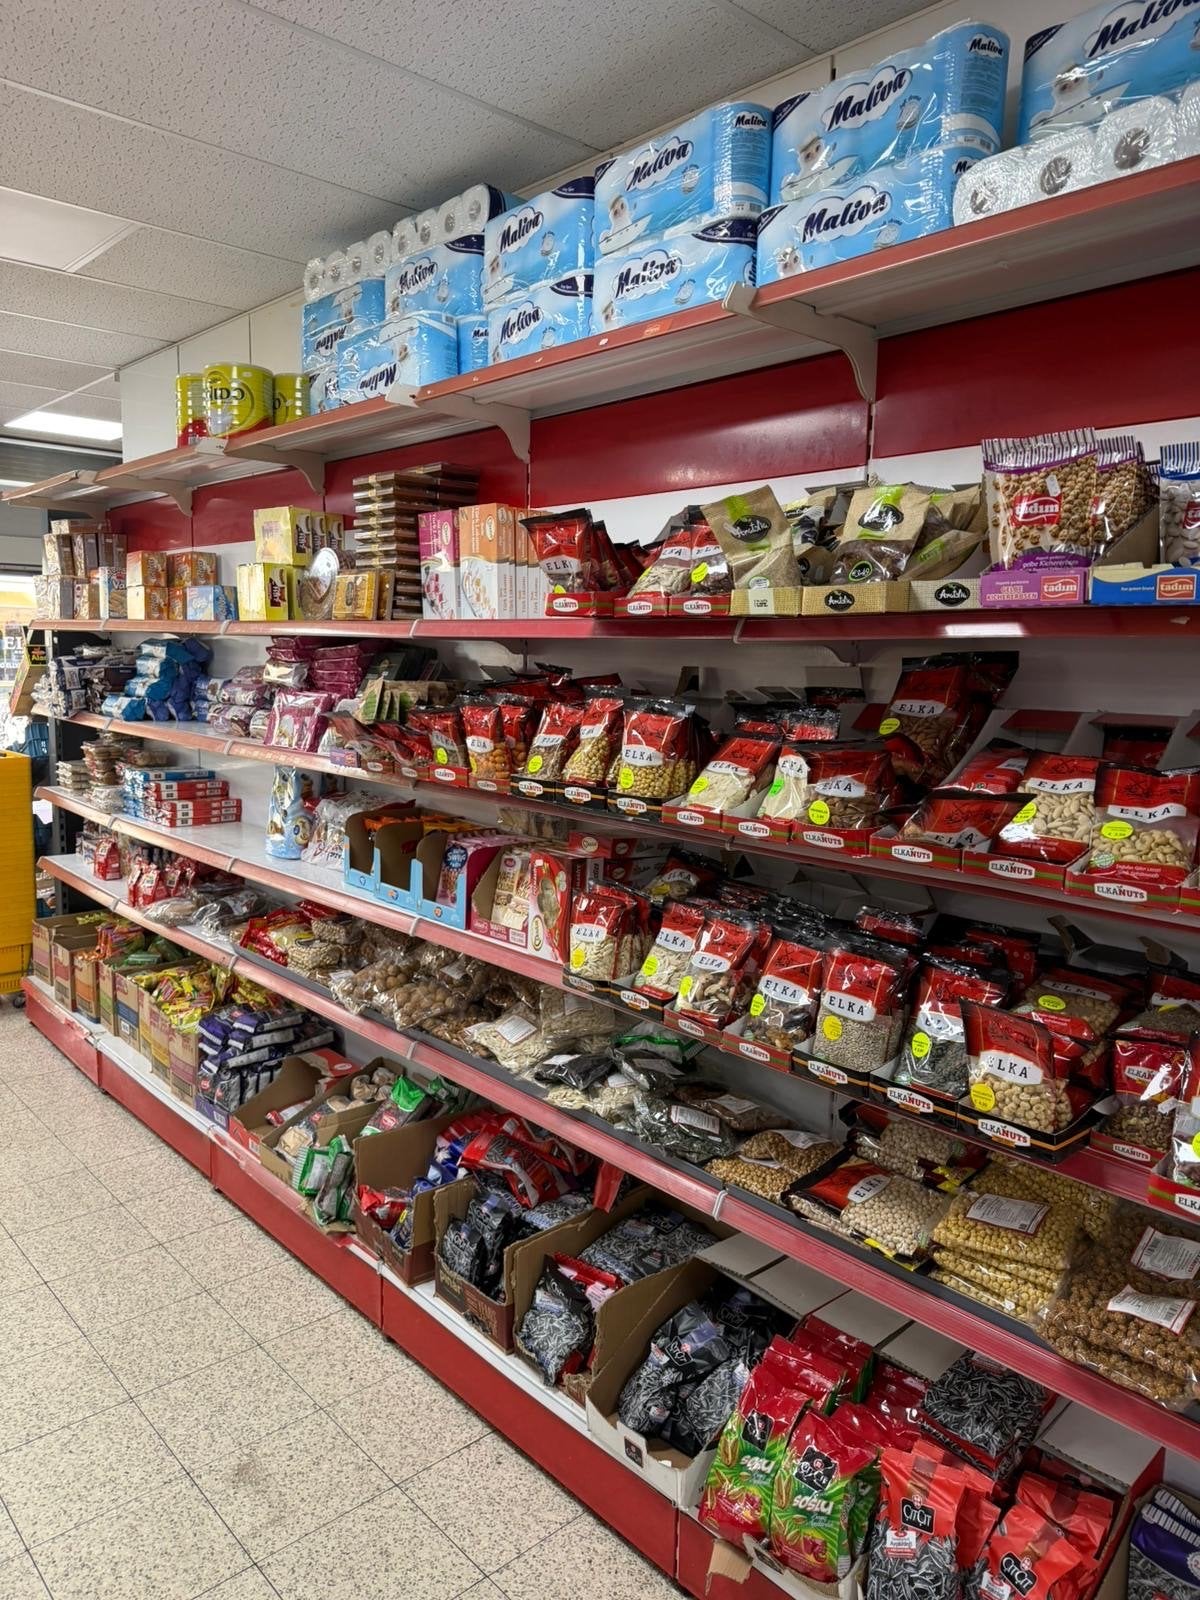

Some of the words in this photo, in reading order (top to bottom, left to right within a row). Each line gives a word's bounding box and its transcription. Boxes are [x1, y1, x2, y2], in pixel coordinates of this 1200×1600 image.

[968, 37, 1003, 56] Maliva
[827, 70, 906, 132] Maliva
[735, 114, 768, 128] Maliva
[626, 142, 690, 192] Maliva
[802, 192, 888, 243] Maliva
[500, 213, 541, 253] Maliva
[400, 261, 436, 295] Maliva
[615, 256, 679, 299] Maliva
[500, 308, 542, 345] Maliva
[315, 326, 347, 350] Maliva
[360, 362, 398, 394] Maliva
[898, 703, 936, 714] ELKA
[625, 749, 653, 761] ELKA
[519, 783, 543, 793] ELKANUTS
[566, 789, 591, 800] ELKANUTS
[1038, 780, 1085, 791] ELKA
[618, 800, 646, 810] ELKANUTS
[1120, 807, 1171, 819] ELKA
[678, 813, 704, 824] ELKANUTS
[739, 823, 769, 834] ELKANUTS
[805, 833, 843, 846] ELKANUTS
[893, 847, 931, 860] ELKANUTS
[990, 862, 1033, 877] ELKANUTS
[1096, 885, 1145, 899] ELKANUTS
[658, 930, 686, 948] ELKA
[764, 979, 797, 999] ELKA
[1051, 982, 1098, 997] ELKA
[829, 995, 866, 1016] ELKA
[740, 1044, 769, 1060] ELKANUTS
[809, 1063, 847, 1082] ELKANUTS
[988, 1055, 1029, 1079] ELKA
[889, 1089, 932, 1110] ELKANUTS
[980, 1122, 1029, 1144] ELKANUTS
[1114, 1144, 1149, 1160] ELKANUTS
[854, 1177, 882, 1198] ELKA
